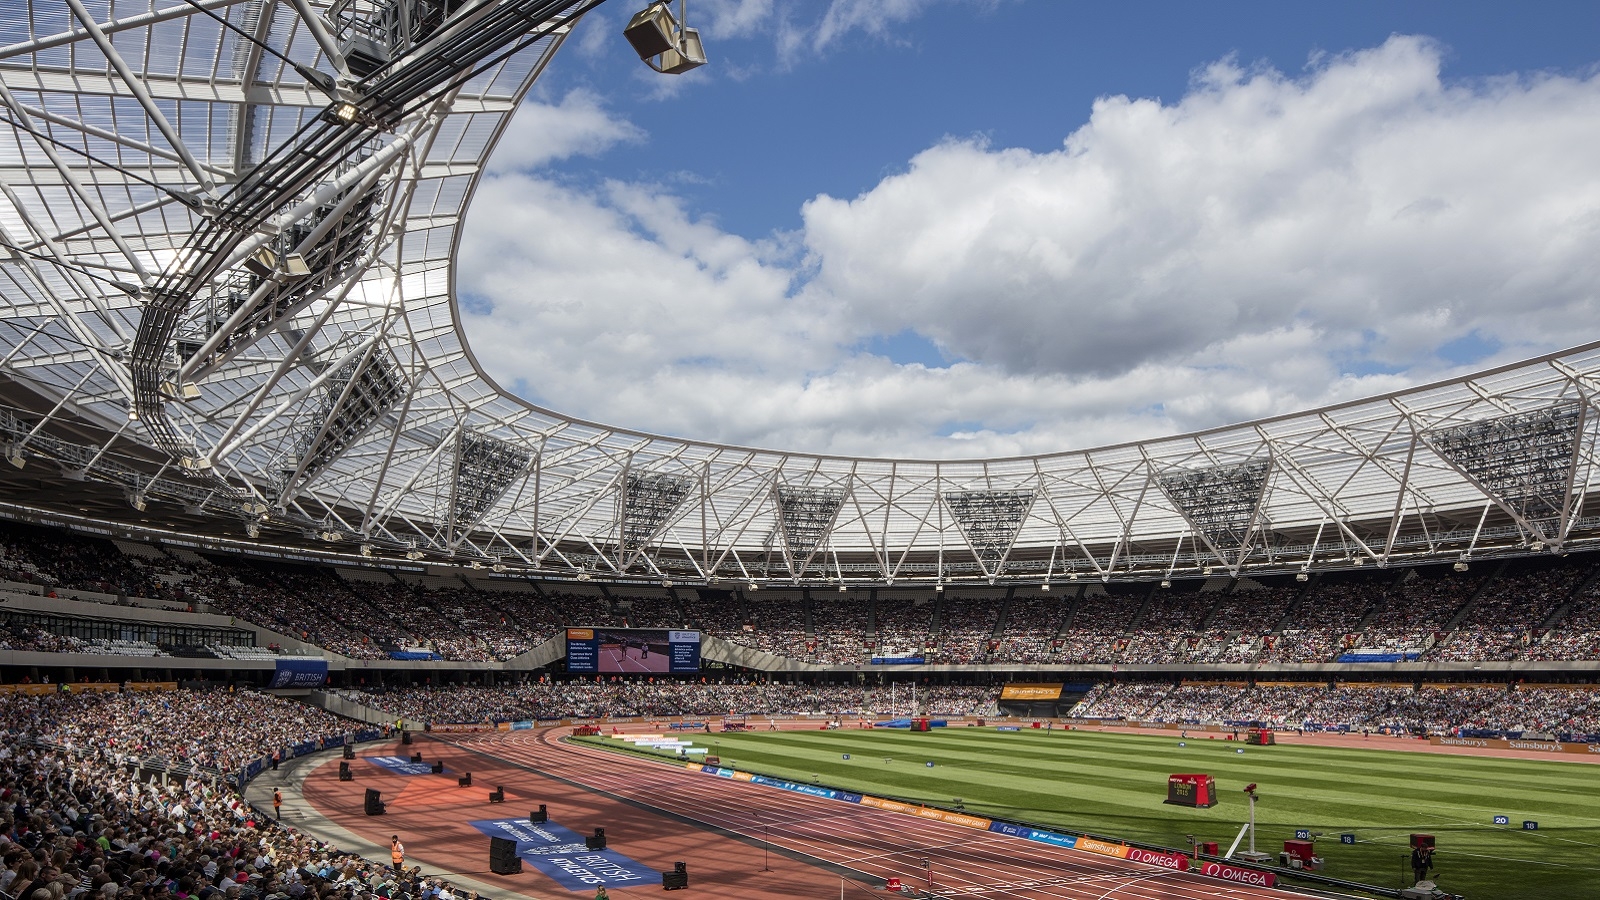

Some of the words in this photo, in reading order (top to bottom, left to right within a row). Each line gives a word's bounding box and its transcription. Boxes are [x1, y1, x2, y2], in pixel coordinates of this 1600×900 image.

[295, 673, 322, 681] BRITISH
[1440, 737, 1487, 747] Sainsbury's
[1509, 741, 1562, 751] Sainsbury's
[1176, 788, 1189, 797] 2015
[920, 809, 942, 819] Sainsbury's
[944, 815, 973, 825] ANNIVERSARY
[972, 819, 987, 829] GAMES
[1081, 840, 1120, 856] Sainsbury's
[575, 854, 642, 882] BRITISH
[1142, 853, 1179, 869] OMEGA
[547, 858, 607, 884] ATHLETICS
[1222, 868, 1267, 887] OMEGA
